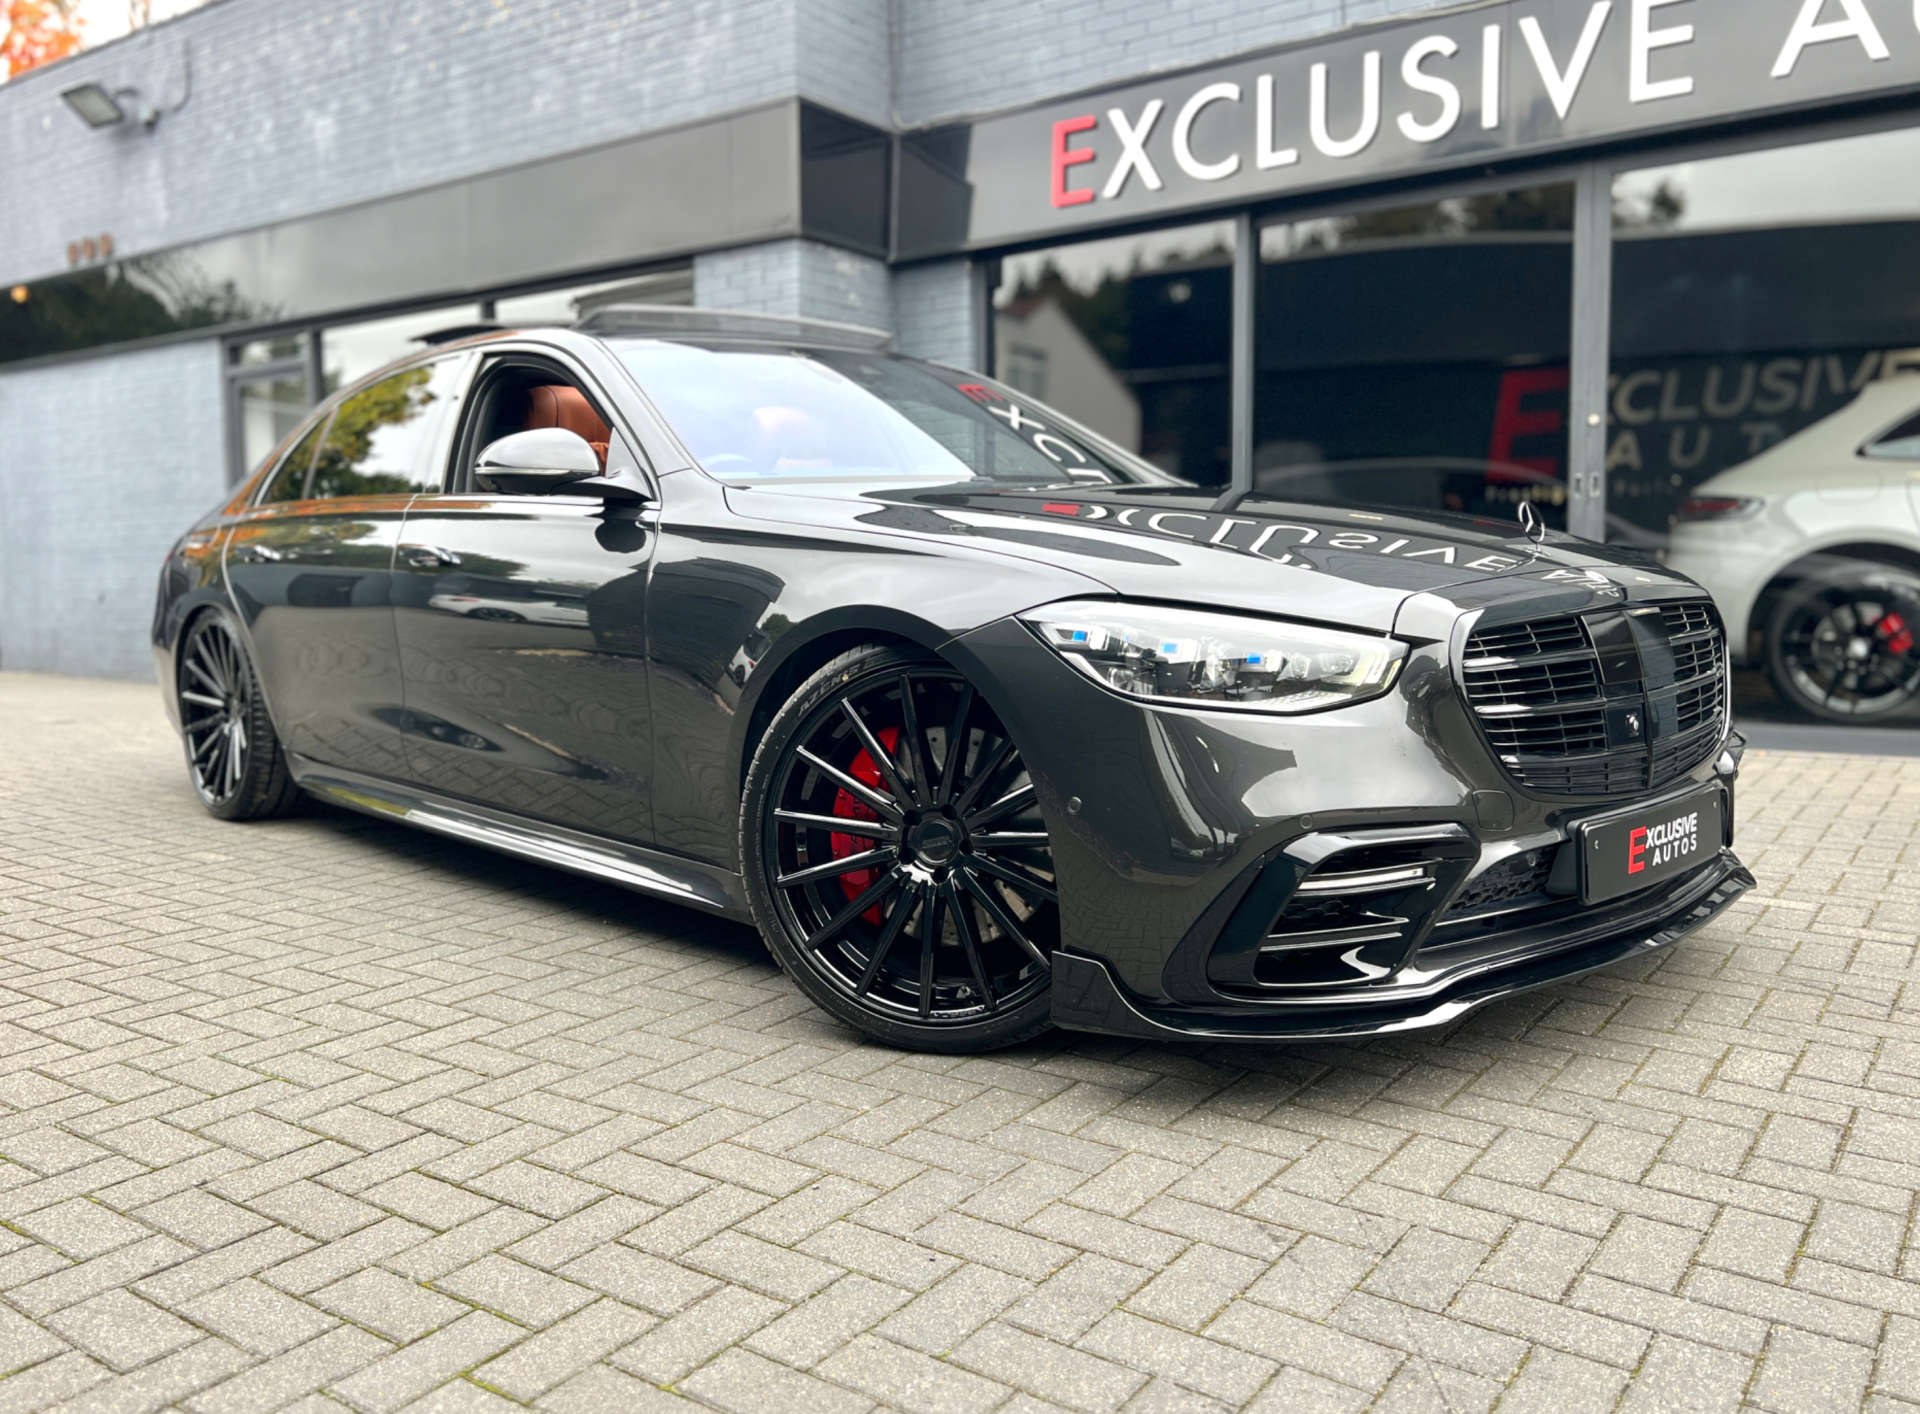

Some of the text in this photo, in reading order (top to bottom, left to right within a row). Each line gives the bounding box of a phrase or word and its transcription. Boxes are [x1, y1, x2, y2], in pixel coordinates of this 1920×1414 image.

[1050, 0, 1920, 208] EXCLUSIVE A
[1486, 347, 1920, 484] ECLUSIV
[1628, 812, 1698, 875] EXCLUSIVE
[1652, 833, 1698, 867] AUTOS
